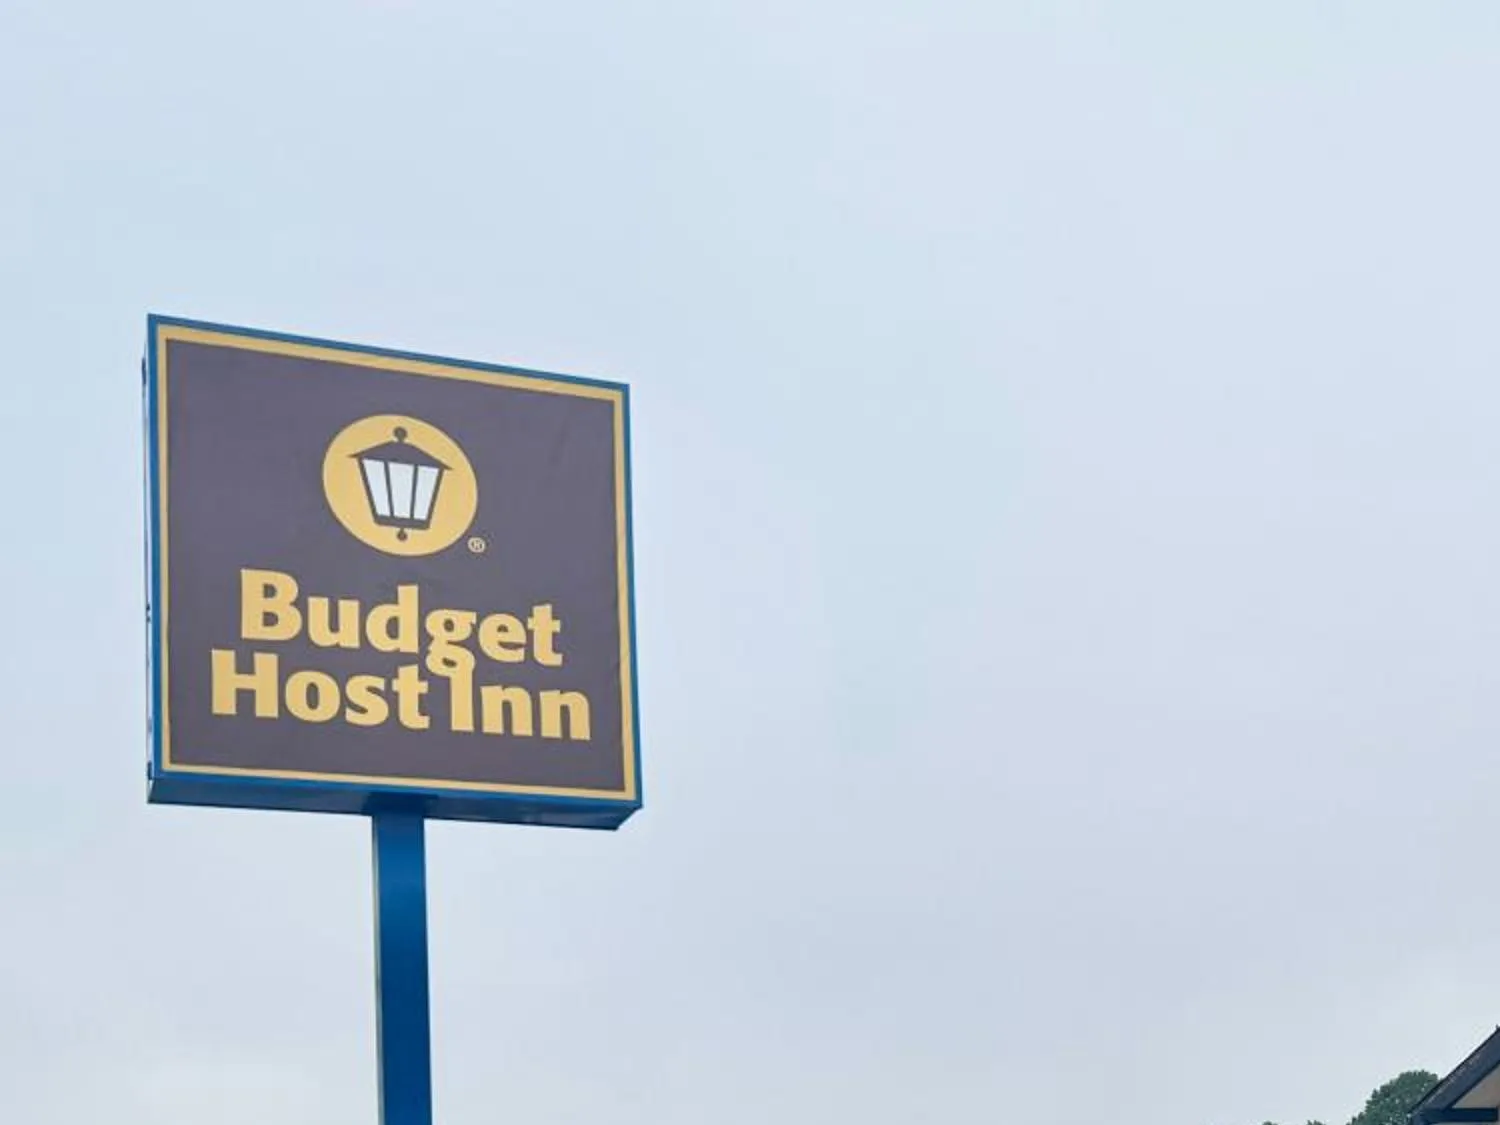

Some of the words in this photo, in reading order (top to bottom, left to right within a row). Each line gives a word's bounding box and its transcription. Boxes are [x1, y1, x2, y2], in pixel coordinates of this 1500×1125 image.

[240, 568, 563, 677] Budget
[210, 648, 430, 730] Host
[449, 658, 592, 741] Inn
